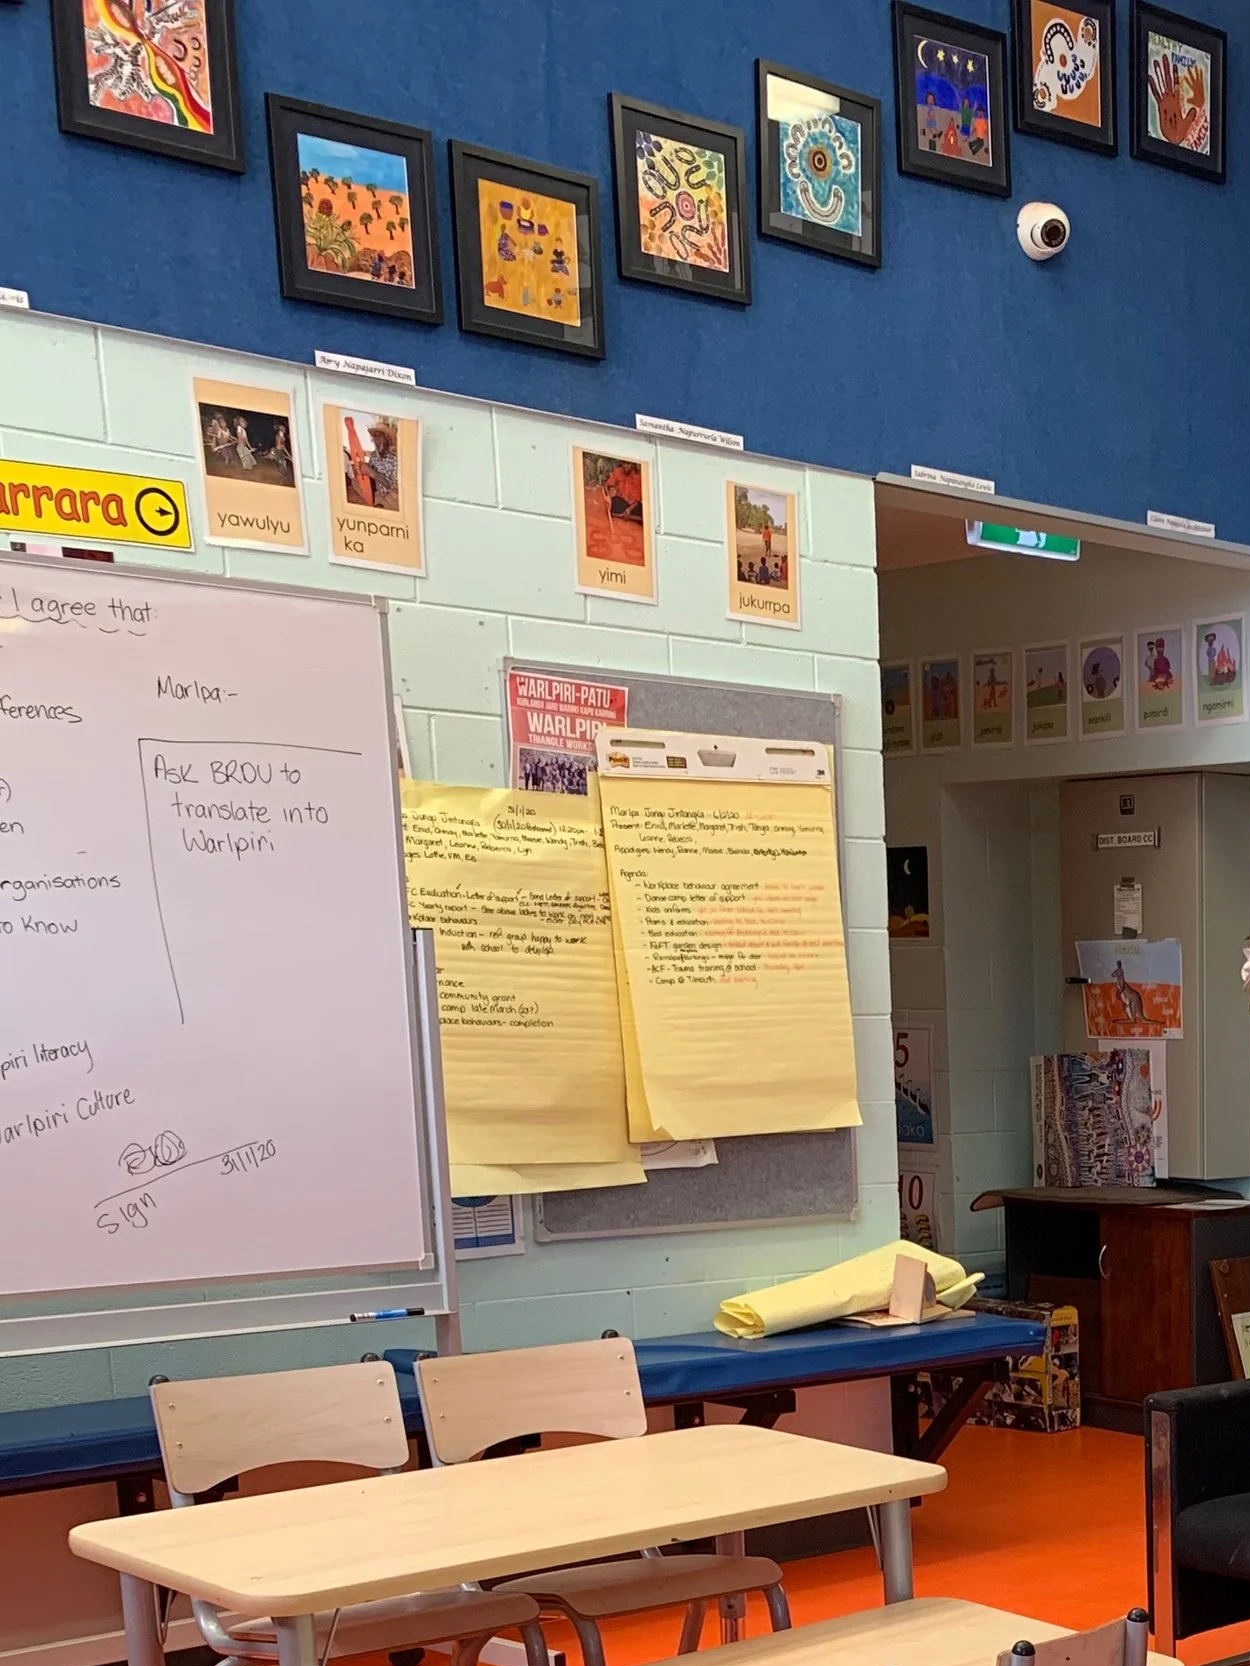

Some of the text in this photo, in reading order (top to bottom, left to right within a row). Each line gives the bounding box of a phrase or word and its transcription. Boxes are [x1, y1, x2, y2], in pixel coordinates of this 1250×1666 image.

[217, 511, 291, 535] yawulyu
[344, 535, 365, 553] ka
[599, 567, 626, 584] yimi
[31, 598, 97, 621] agree
[739, 592, 790, 615] jukurrpa
[516, 676, 611, 708] WARLPIRI-PATU
[528, 733, 564, 748] TRIANGLE
[280, 762, 301, 786] to
[171, 791, 329, 825] translate into
[182, 829, 275, 861] Warlpiri
[1117, 835, 1141, 844] BOARD
[33, 1040, 94, 1074] literacy
[895, 1033, 909, 1067] 5
